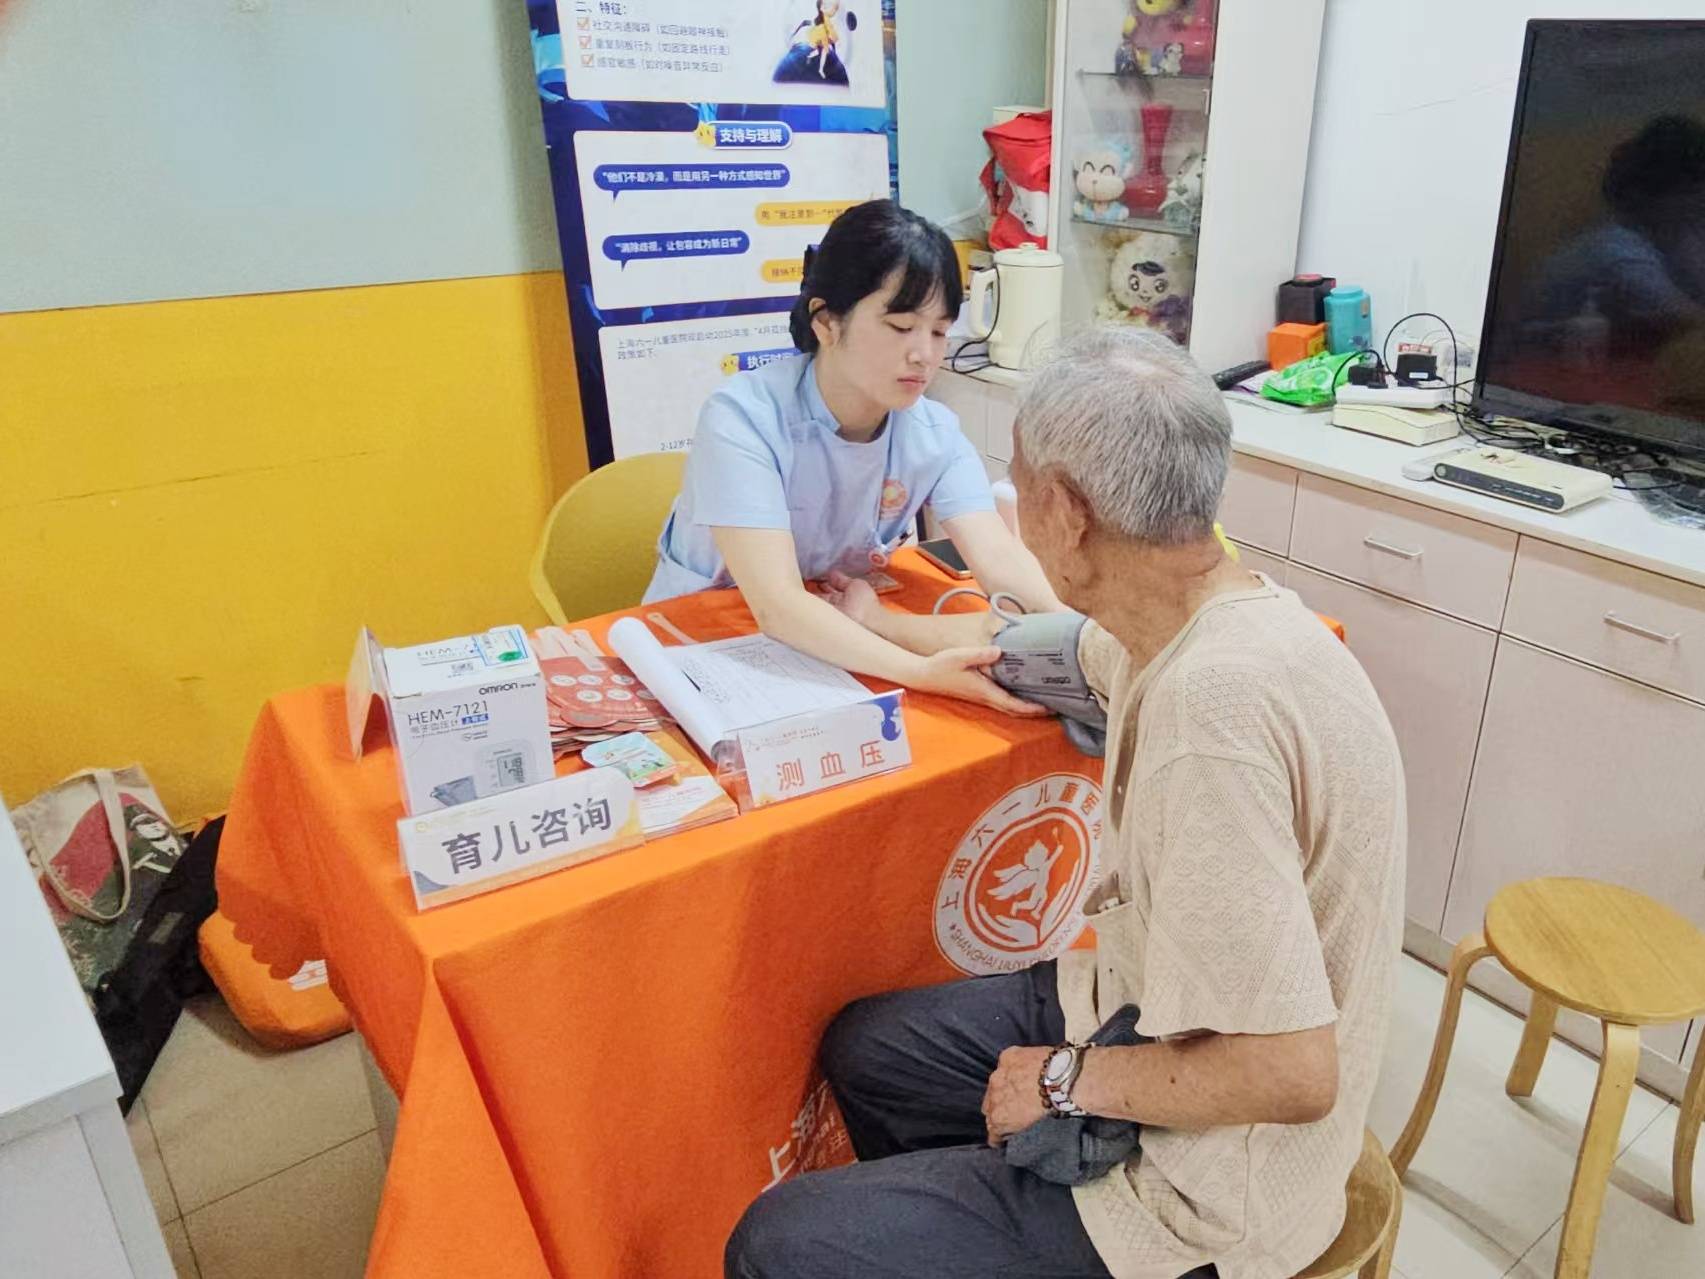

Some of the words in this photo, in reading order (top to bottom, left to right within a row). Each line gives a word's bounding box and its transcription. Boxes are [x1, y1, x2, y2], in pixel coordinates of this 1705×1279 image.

[719, 126, 783, 144] 支持与理解
[407, 699, 489, 726] HEM-7121
[775, 739, 886, 791] 测血压
[441, 797, 613, 874] 育儿咨询
